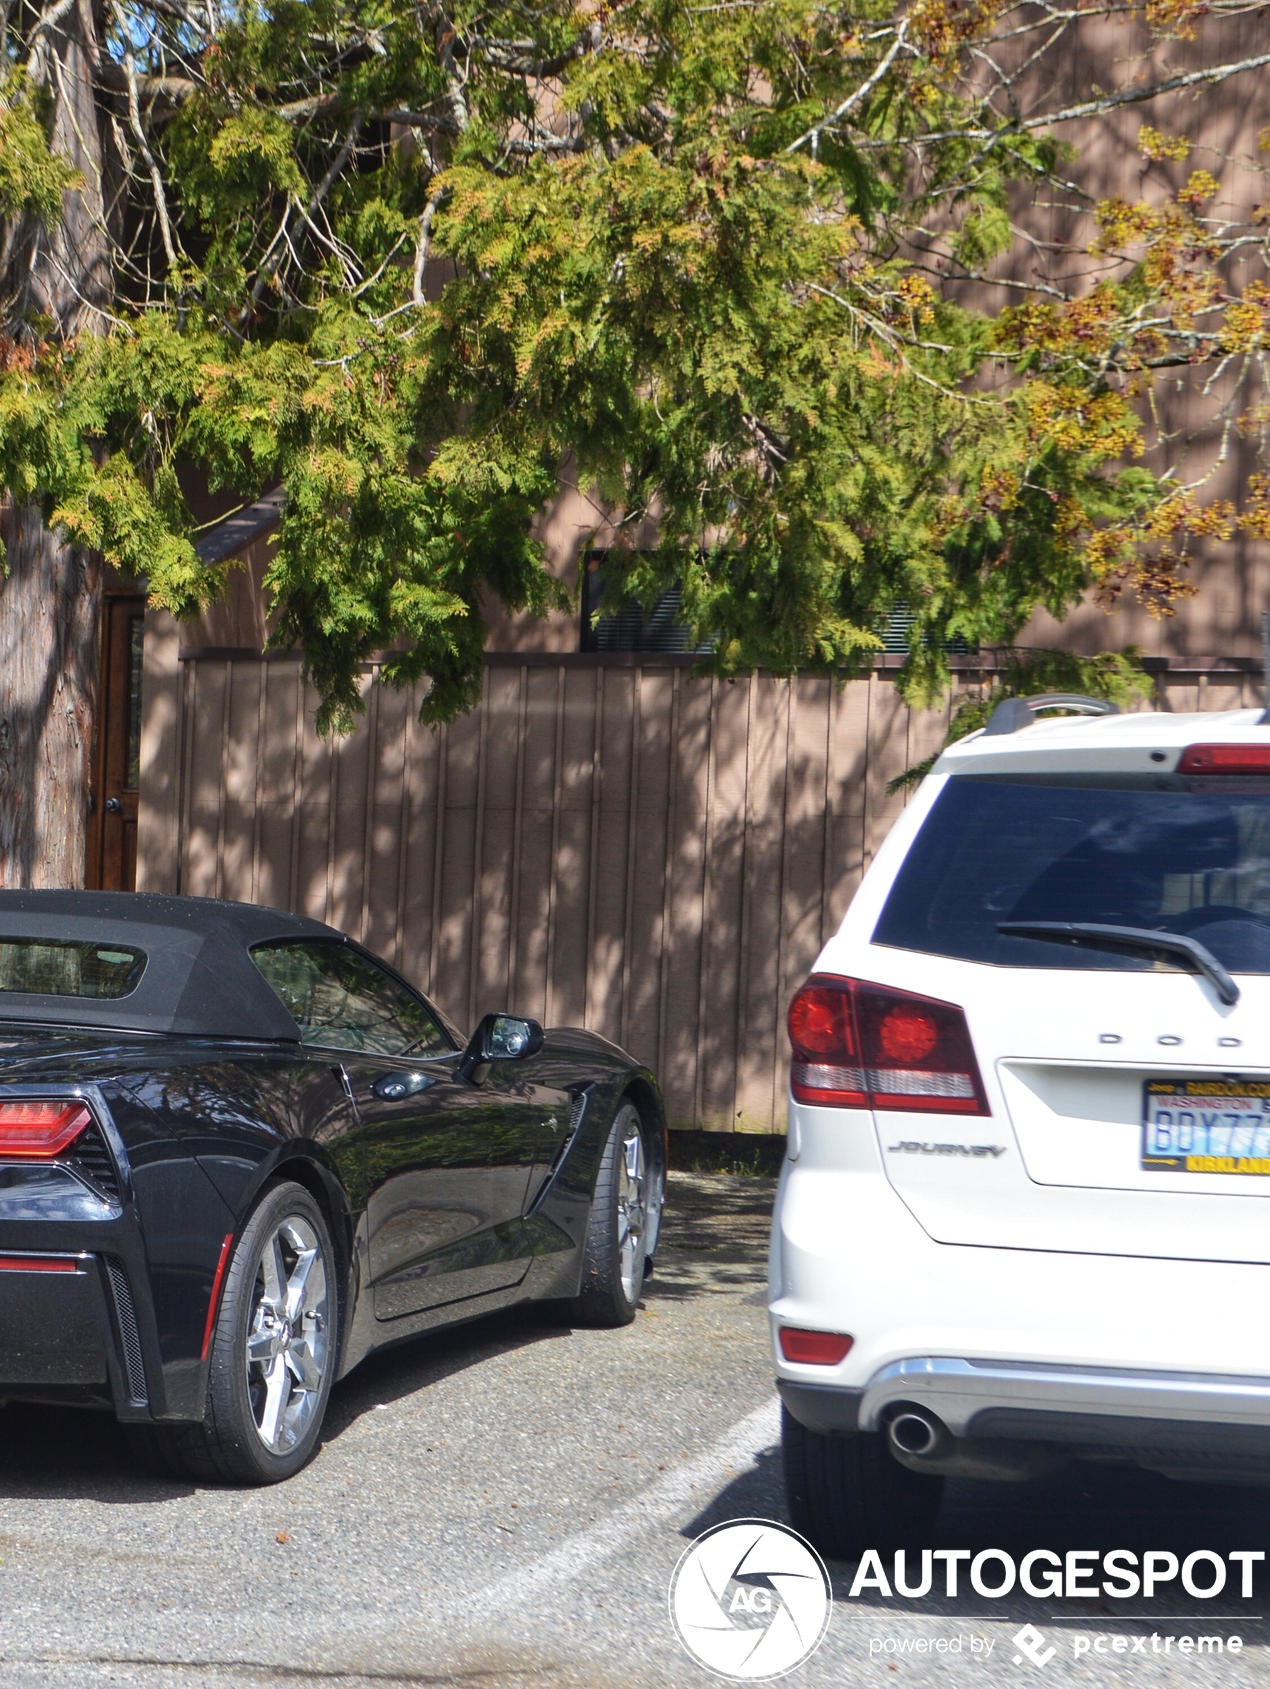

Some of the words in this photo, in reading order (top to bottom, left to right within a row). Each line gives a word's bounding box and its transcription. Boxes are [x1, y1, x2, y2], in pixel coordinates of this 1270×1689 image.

[1156, 1096, 1252, 1110] WASHINGTON
[1155, 1110, 1270, 1154] BDY77
[888, 1141, 1006, 1158] JOURNEY
